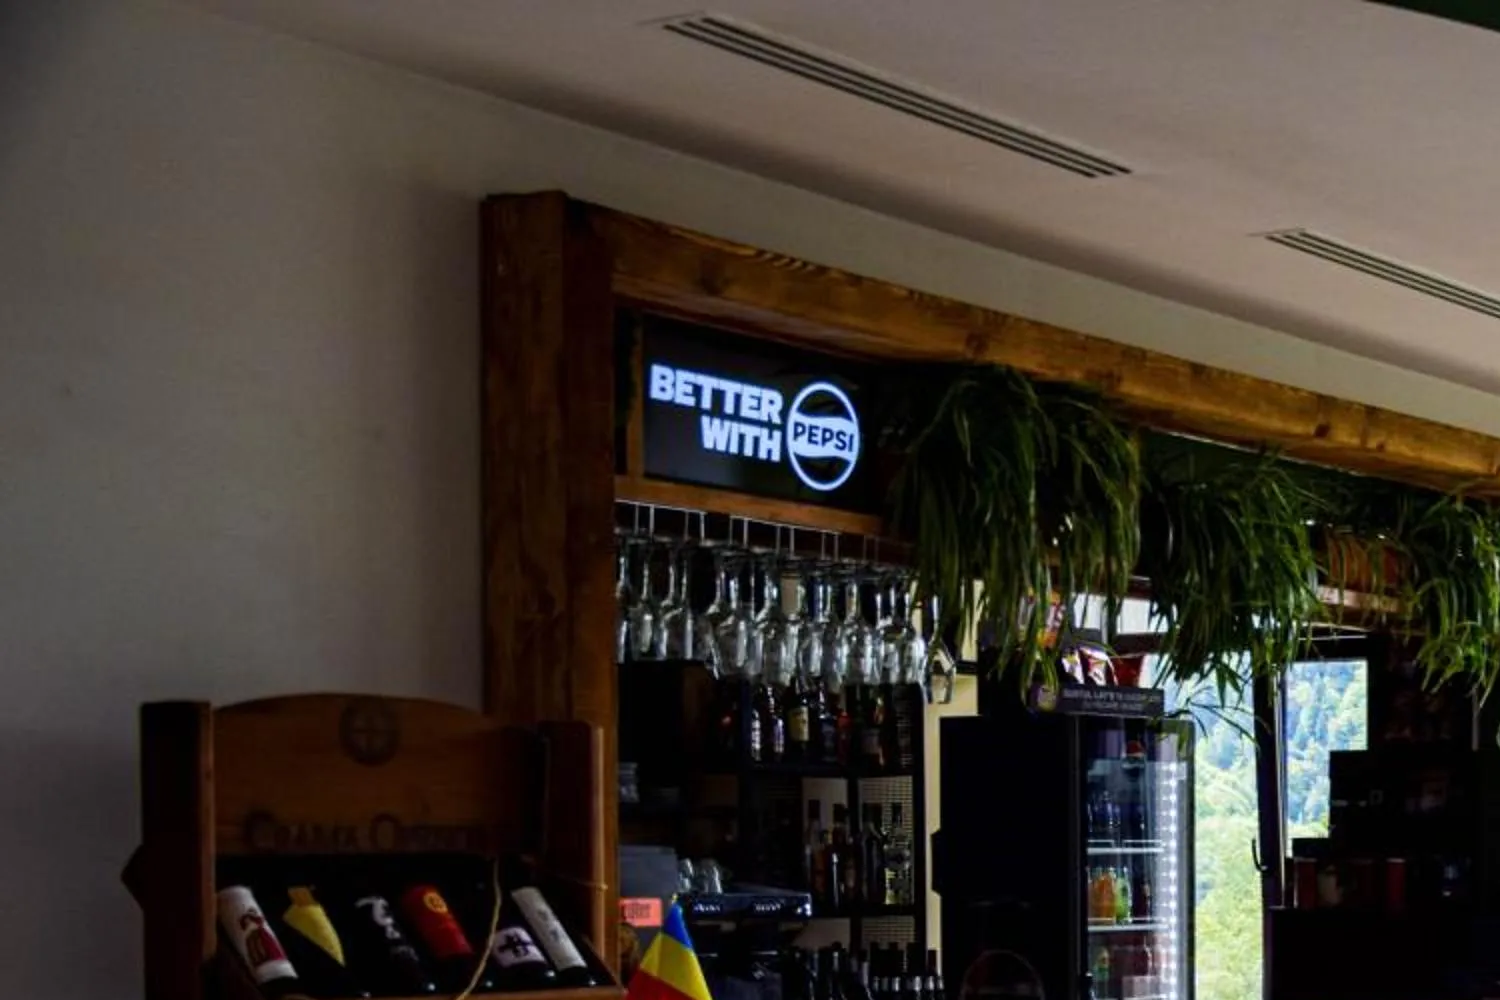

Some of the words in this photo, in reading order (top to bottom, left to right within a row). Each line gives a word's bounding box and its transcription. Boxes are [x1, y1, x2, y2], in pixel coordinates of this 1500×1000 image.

[650, 364, 783, 425] BETTER
[701, 415, 781, 462] WITH
[793, 421, 855, 453] PEPSI
